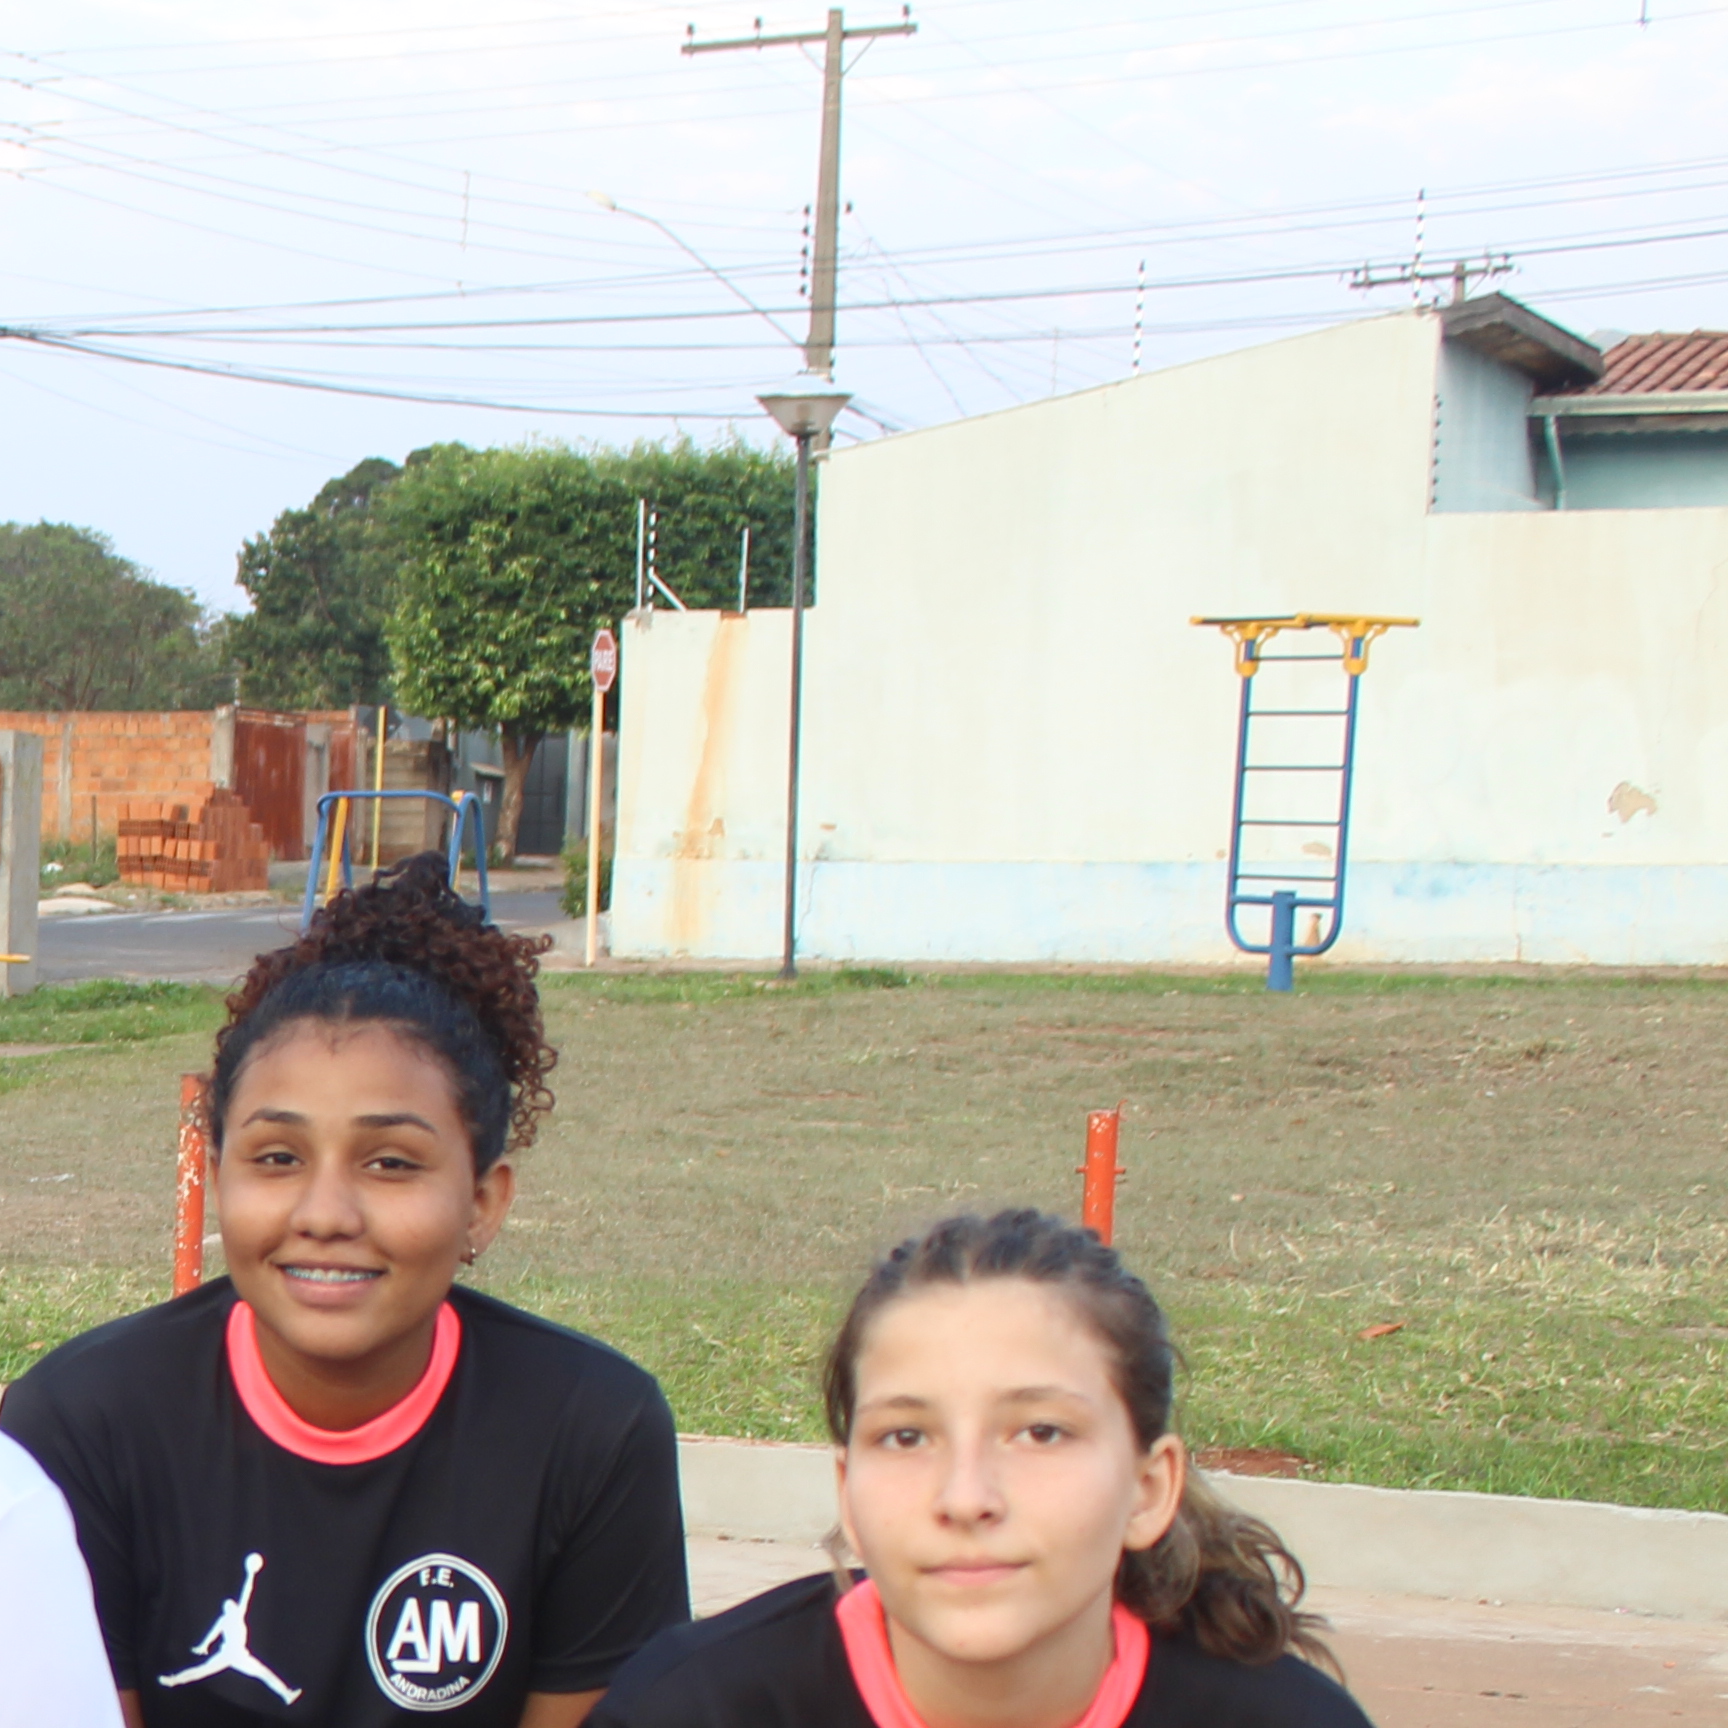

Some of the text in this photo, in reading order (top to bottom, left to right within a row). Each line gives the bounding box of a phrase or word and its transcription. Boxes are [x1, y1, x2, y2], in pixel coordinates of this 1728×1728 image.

[593, 649, 614, 671] PARE
[386, 1597, 480, 1674] AM
[389, 1672, 471, 1702] ANDRADINA
